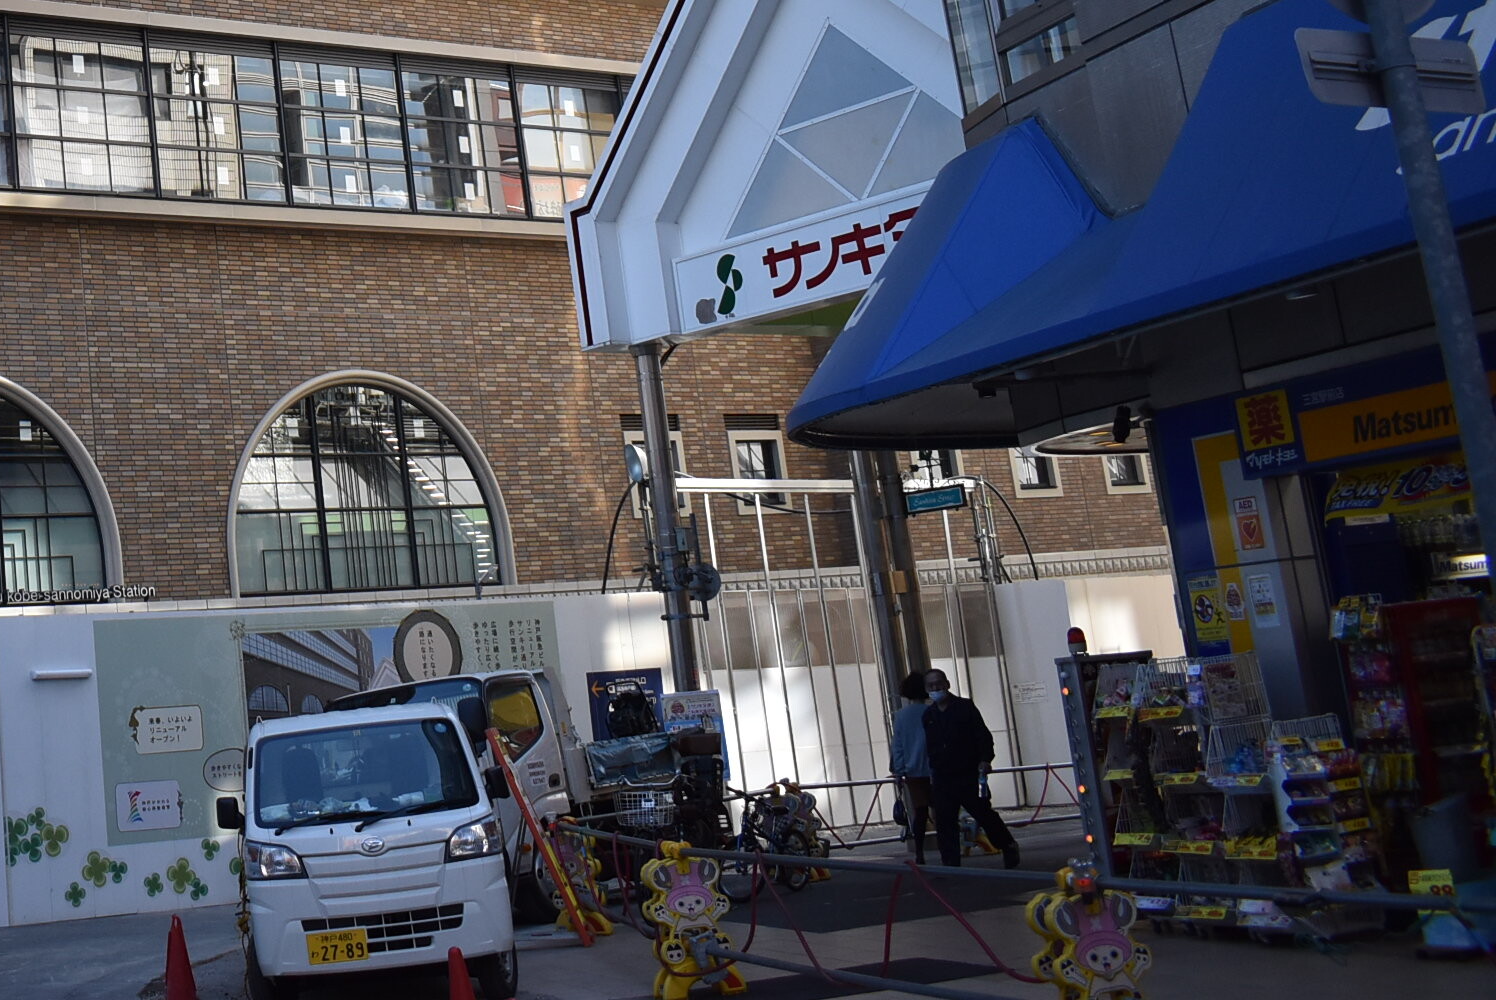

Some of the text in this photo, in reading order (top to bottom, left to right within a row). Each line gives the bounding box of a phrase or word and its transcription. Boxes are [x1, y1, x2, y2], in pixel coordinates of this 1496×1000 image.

[1246, 394, 1286, 447] 薬
[1238, 500, 1253, 510] AED
[113, 584, 156, 598] Station
[482, 621, 494, 674] ゆったり広く
[526, 619, 536, 670] リニューアル
[321, 941, 365, 962] 27-89
